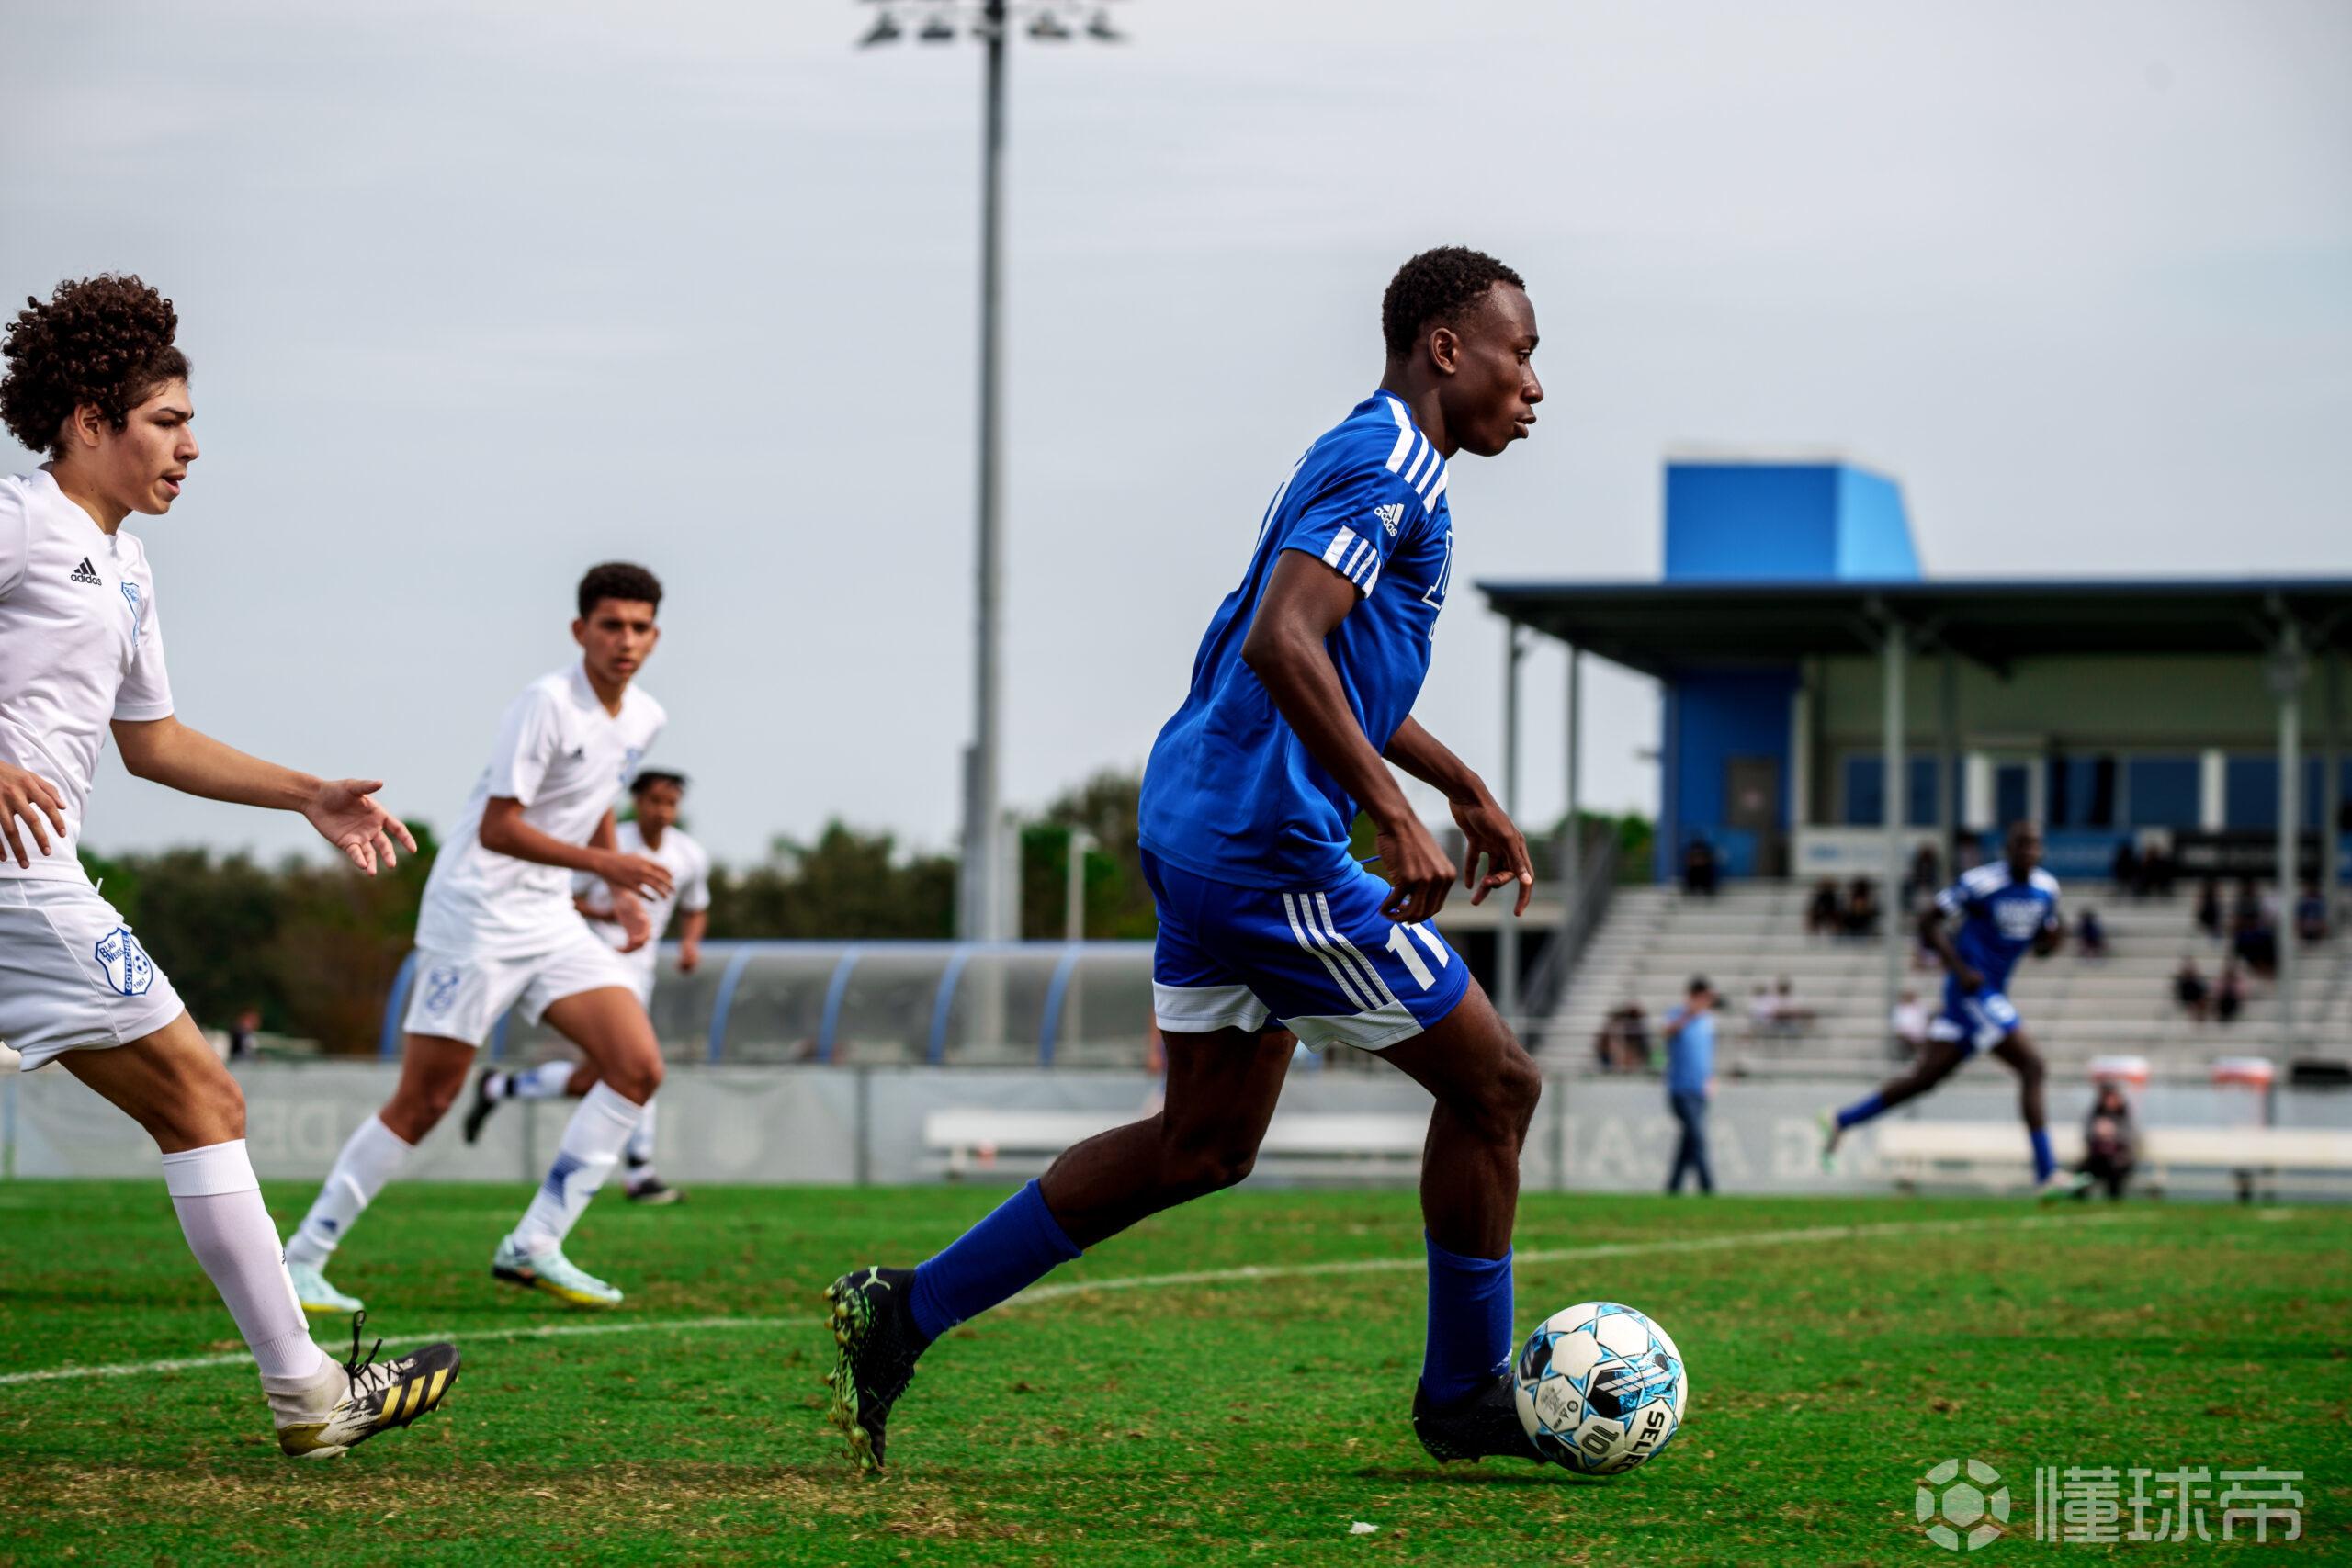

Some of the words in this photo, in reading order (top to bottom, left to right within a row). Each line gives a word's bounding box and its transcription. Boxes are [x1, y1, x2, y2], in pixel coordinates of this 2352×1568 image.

[1374, 506, 1397, 536] addas
[71, 572, 102, 586] adidas
[99, 940, 116, 957] BLAU
[105, 947, 124, 963] WEISS
[1582, 1425, 1620, 1455] 10
[1611, 1410, 1665, 1472] SELEC
